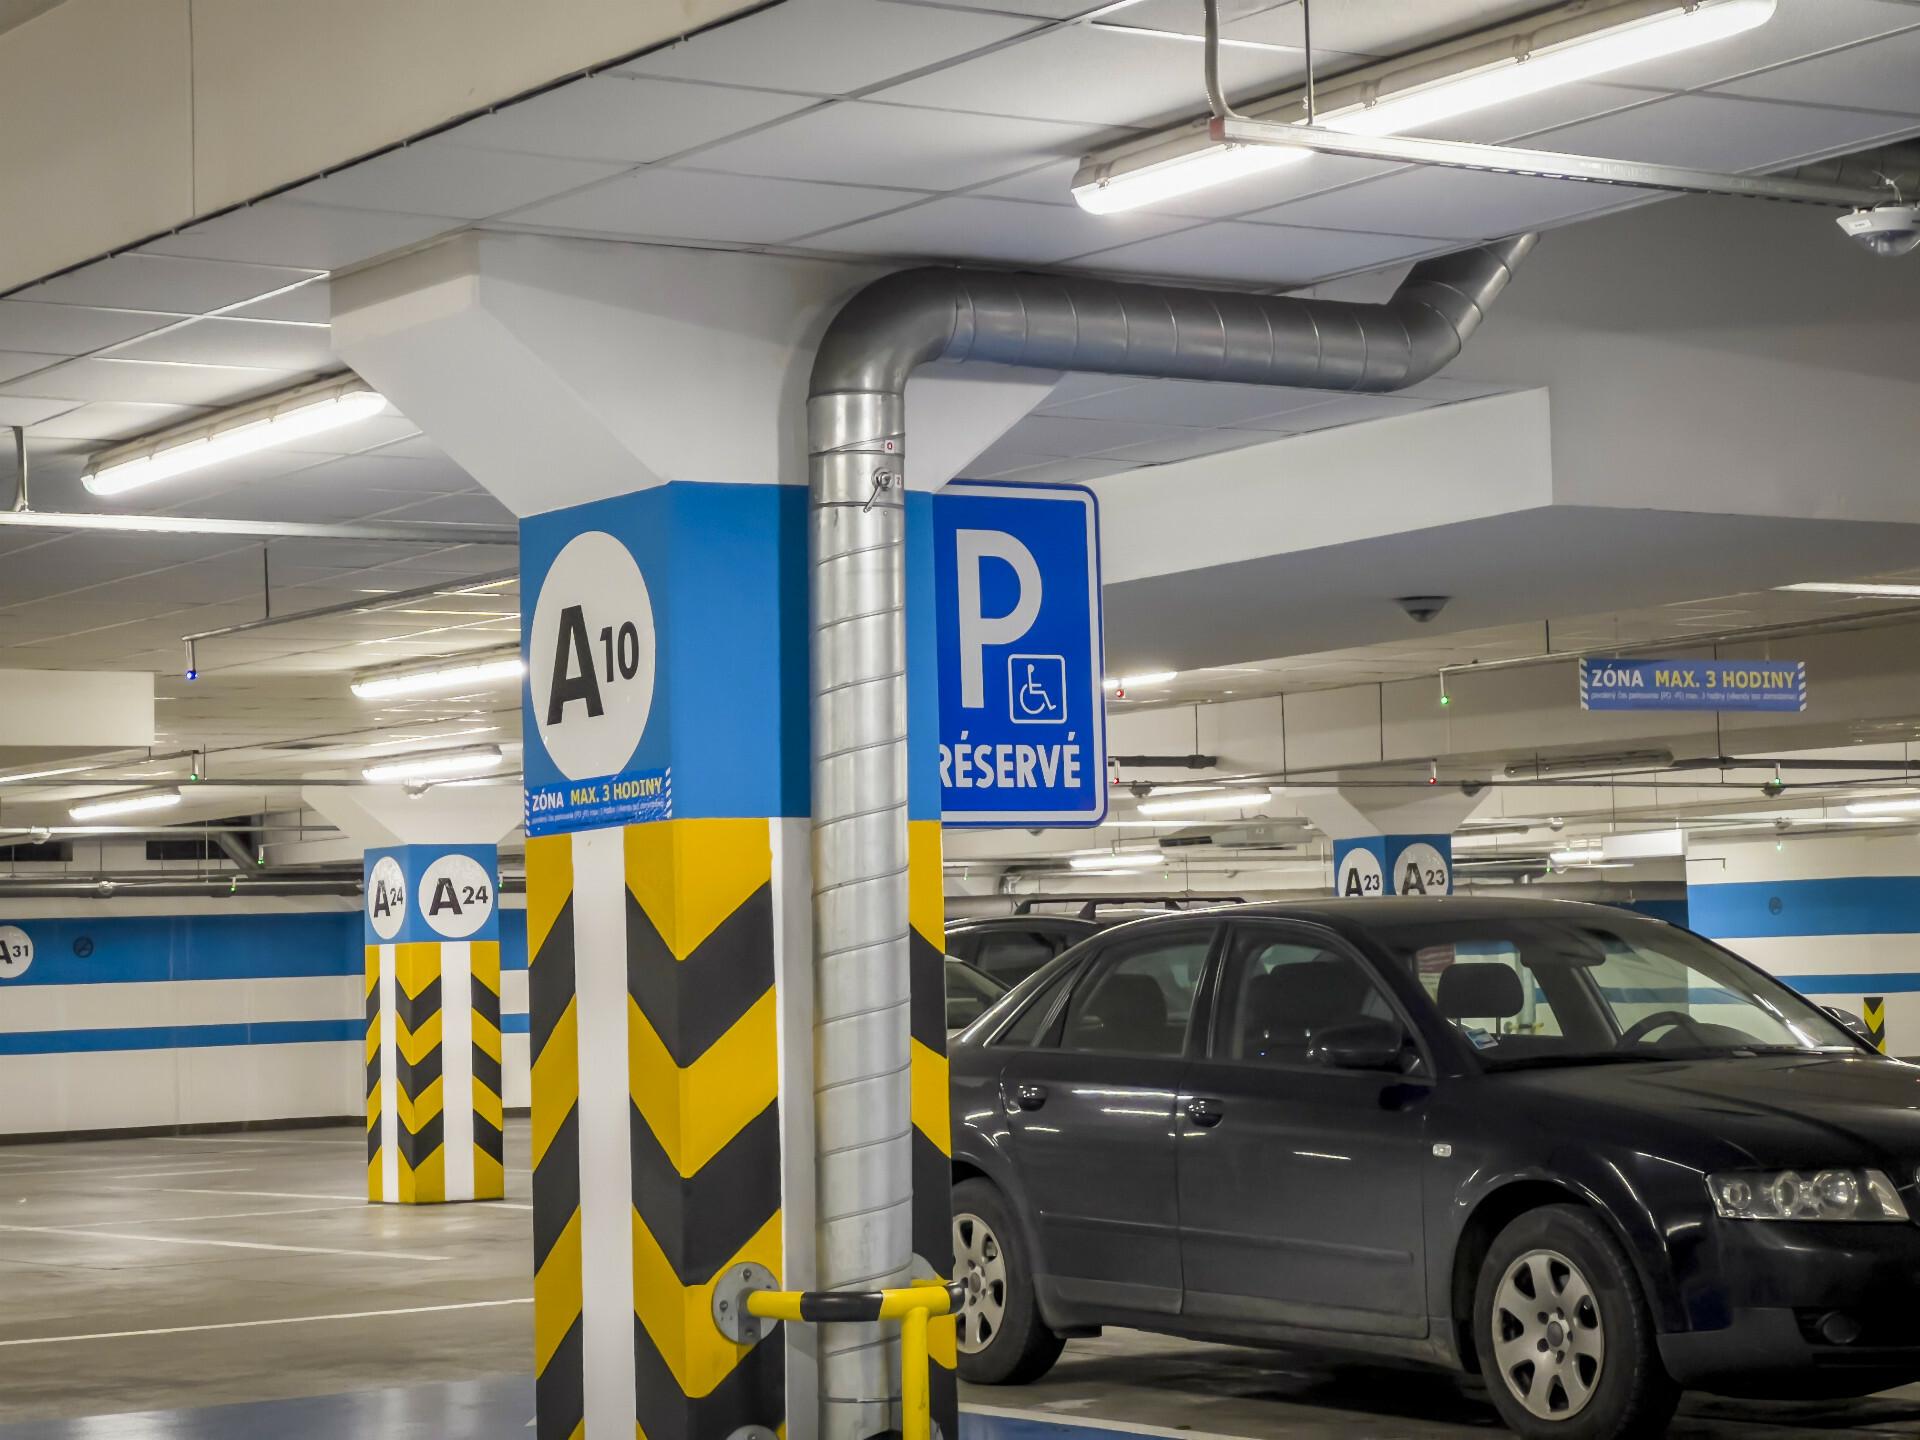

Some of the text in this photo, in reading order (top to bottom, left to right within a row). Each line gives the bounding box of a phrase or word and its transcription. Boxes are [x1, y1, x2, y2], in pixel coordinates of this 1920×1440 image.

[956, 528, 1043, 709] P
[546, 604, 640, 725] A10
[1592, 664, 1796, 689] ZÓNA MAX. 3 HODINY
[532, 776, 663, 812] ZÓNA MAX. 3 HODINY
[373, 880, 404, 918] A24
[428, 877, 488, 916] A24
